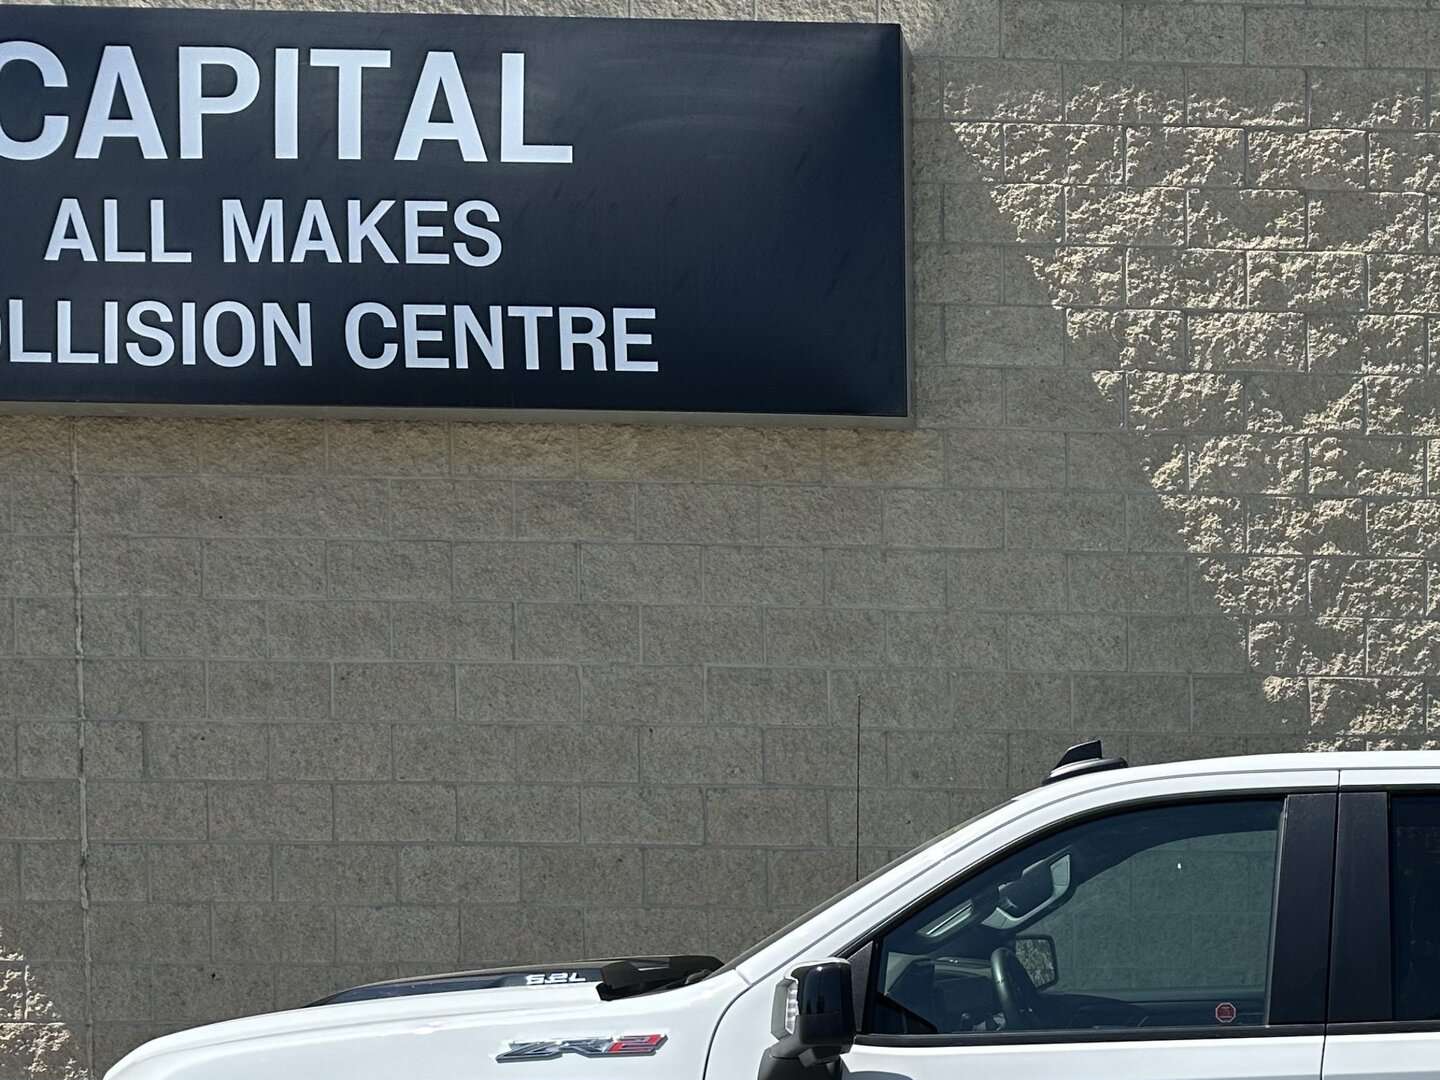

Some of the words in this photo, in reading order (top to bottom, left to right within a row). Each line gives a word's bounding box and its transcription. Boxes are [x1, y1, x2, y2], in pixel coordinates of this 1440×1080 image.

[0, 41, 573, 163] CAPITAL
[44, 199, 192, 263] ALL
[223, 200, 502, 267] MAKES
[0, 299, 313, 368] LLISION
[345, 302, 659, 372] CENTRE
[495, 1033, 669, 1064] ZR2
